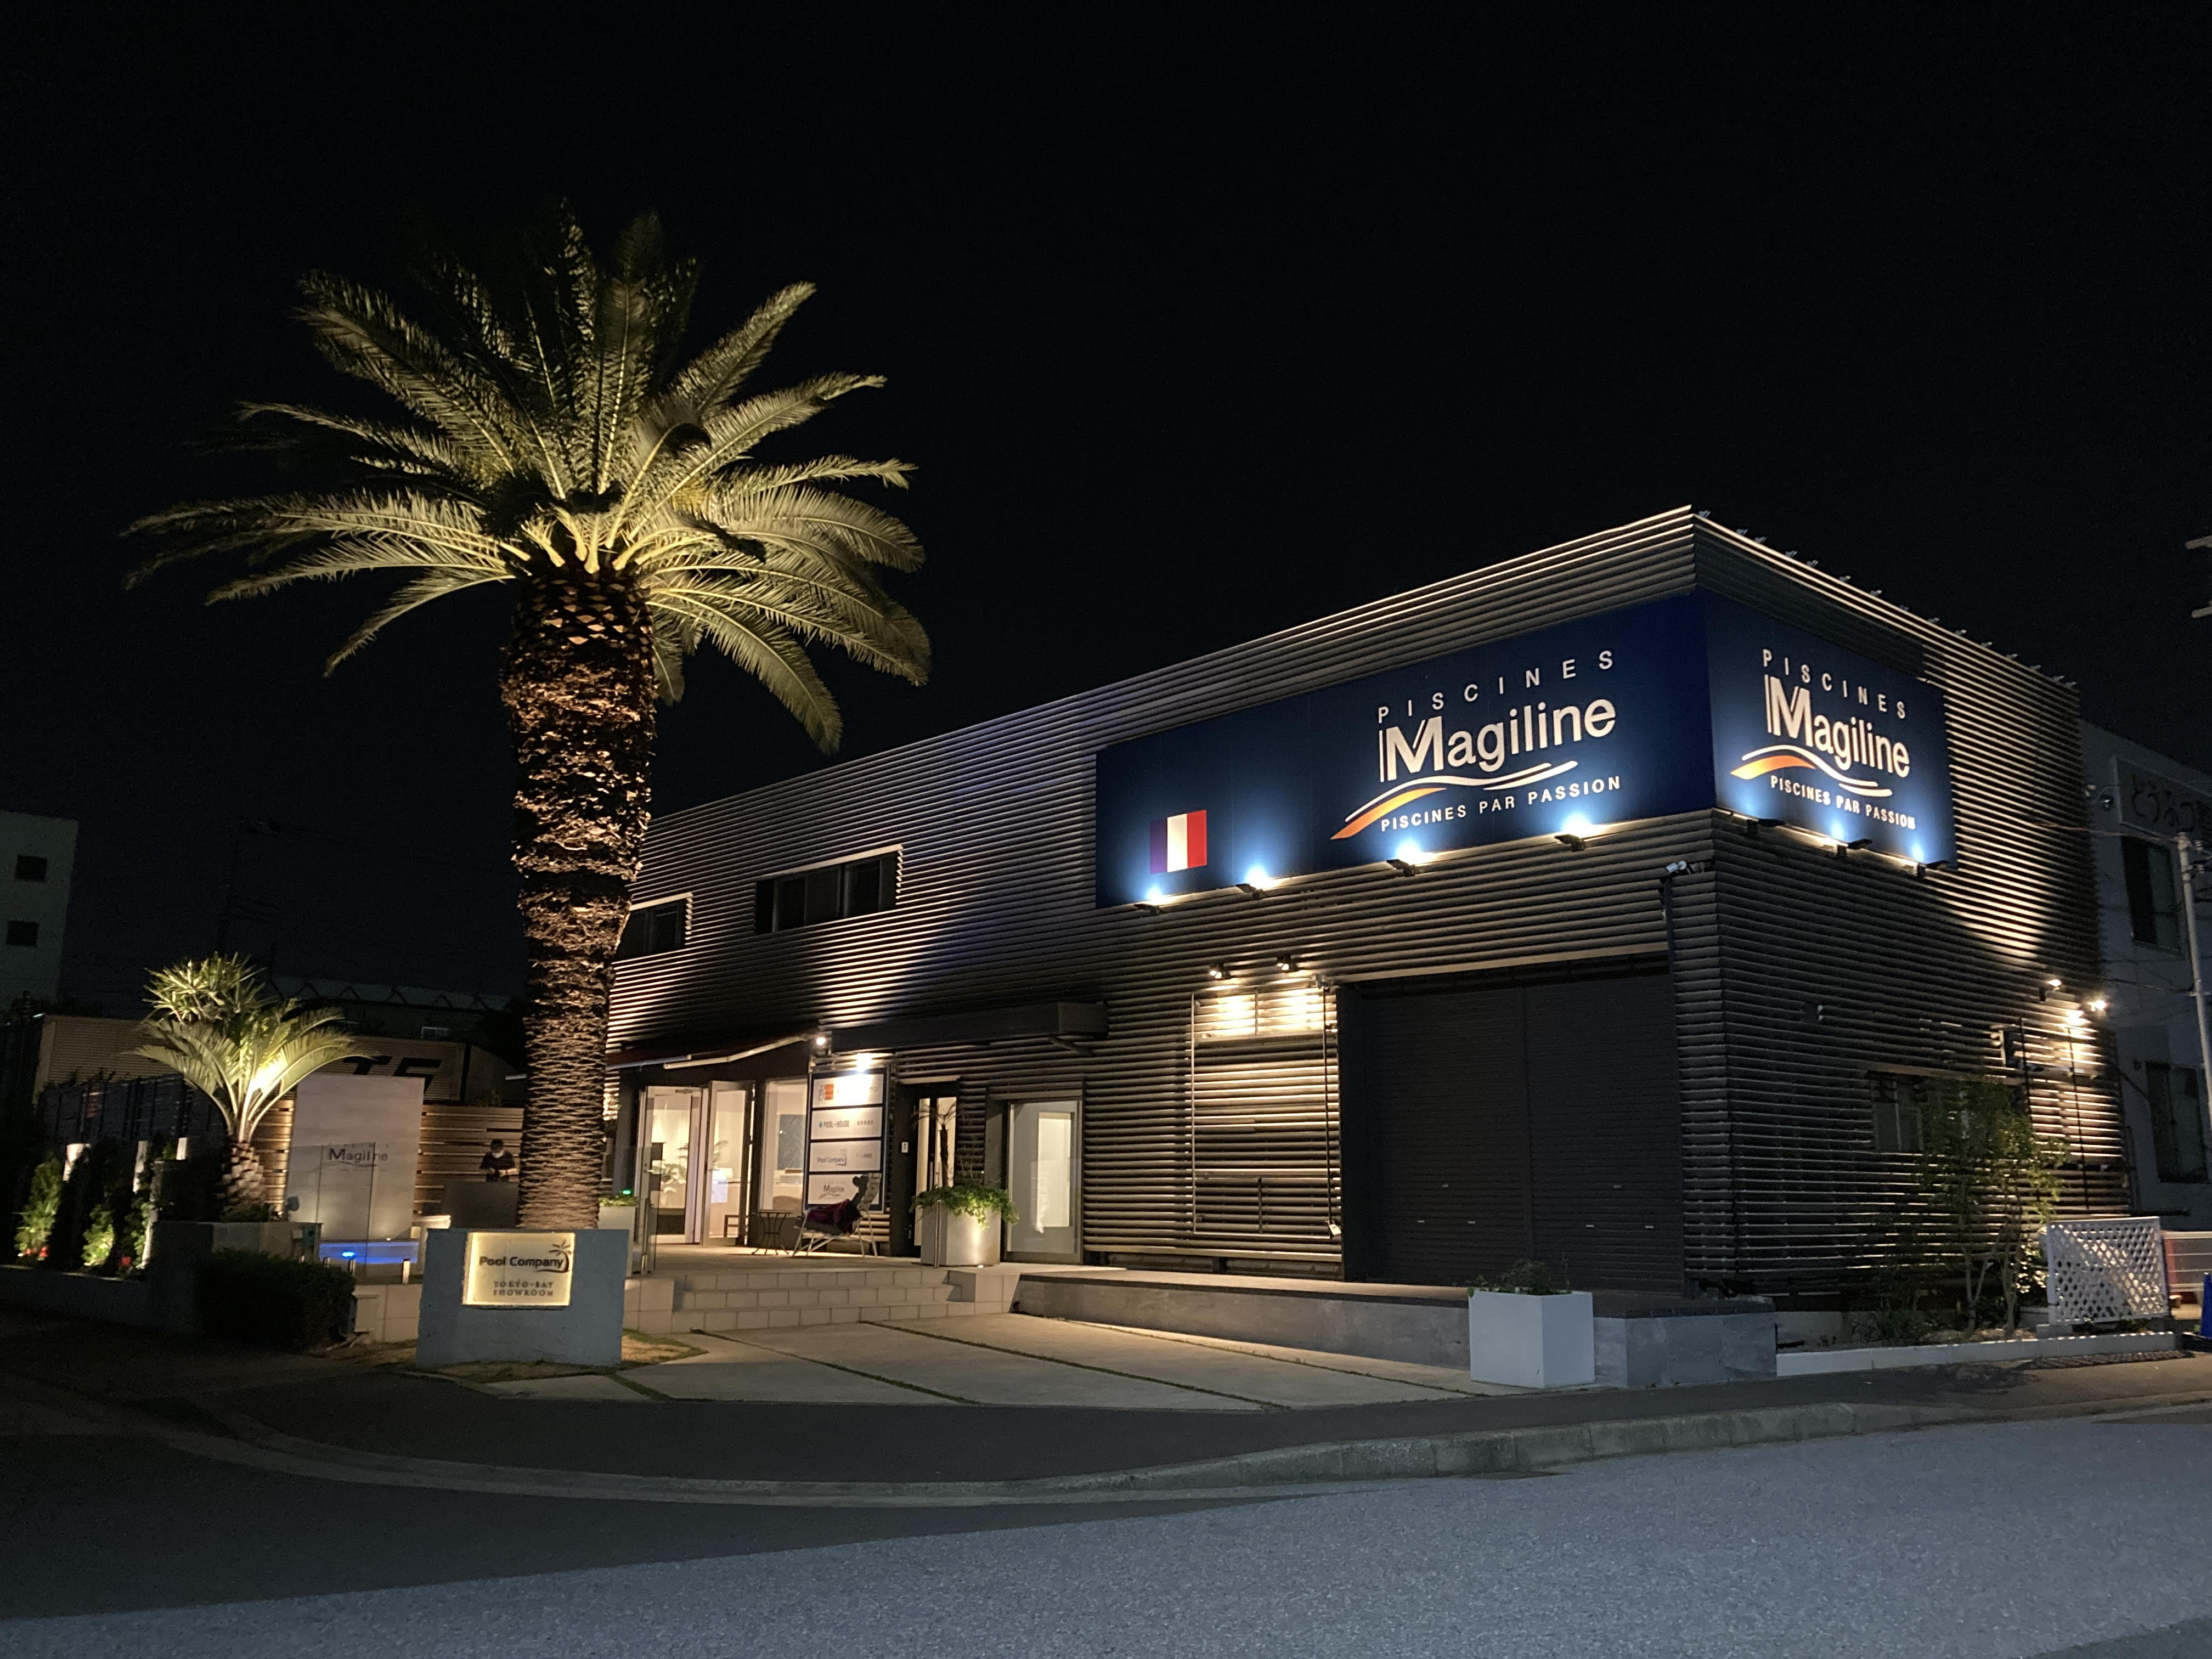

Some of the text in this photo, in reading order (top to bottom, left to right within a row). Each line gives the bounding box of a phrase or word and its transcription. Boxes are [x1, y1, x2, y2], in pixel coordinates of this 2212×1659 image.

[1378, 650, 1613, 724] PISCINES
[1762, 649, 1905, 719] PISCINES
[1379, 698, 1616, 782] Magiline
[1764, 674, 1910, 778] Magiline
[1381, 776, 1620, 831] PISCINES PAR PASSION
[1771, 775, 1915, 830] PISCINES PAR PASSION
[479, 1256, 564, 1269] Pool Company
